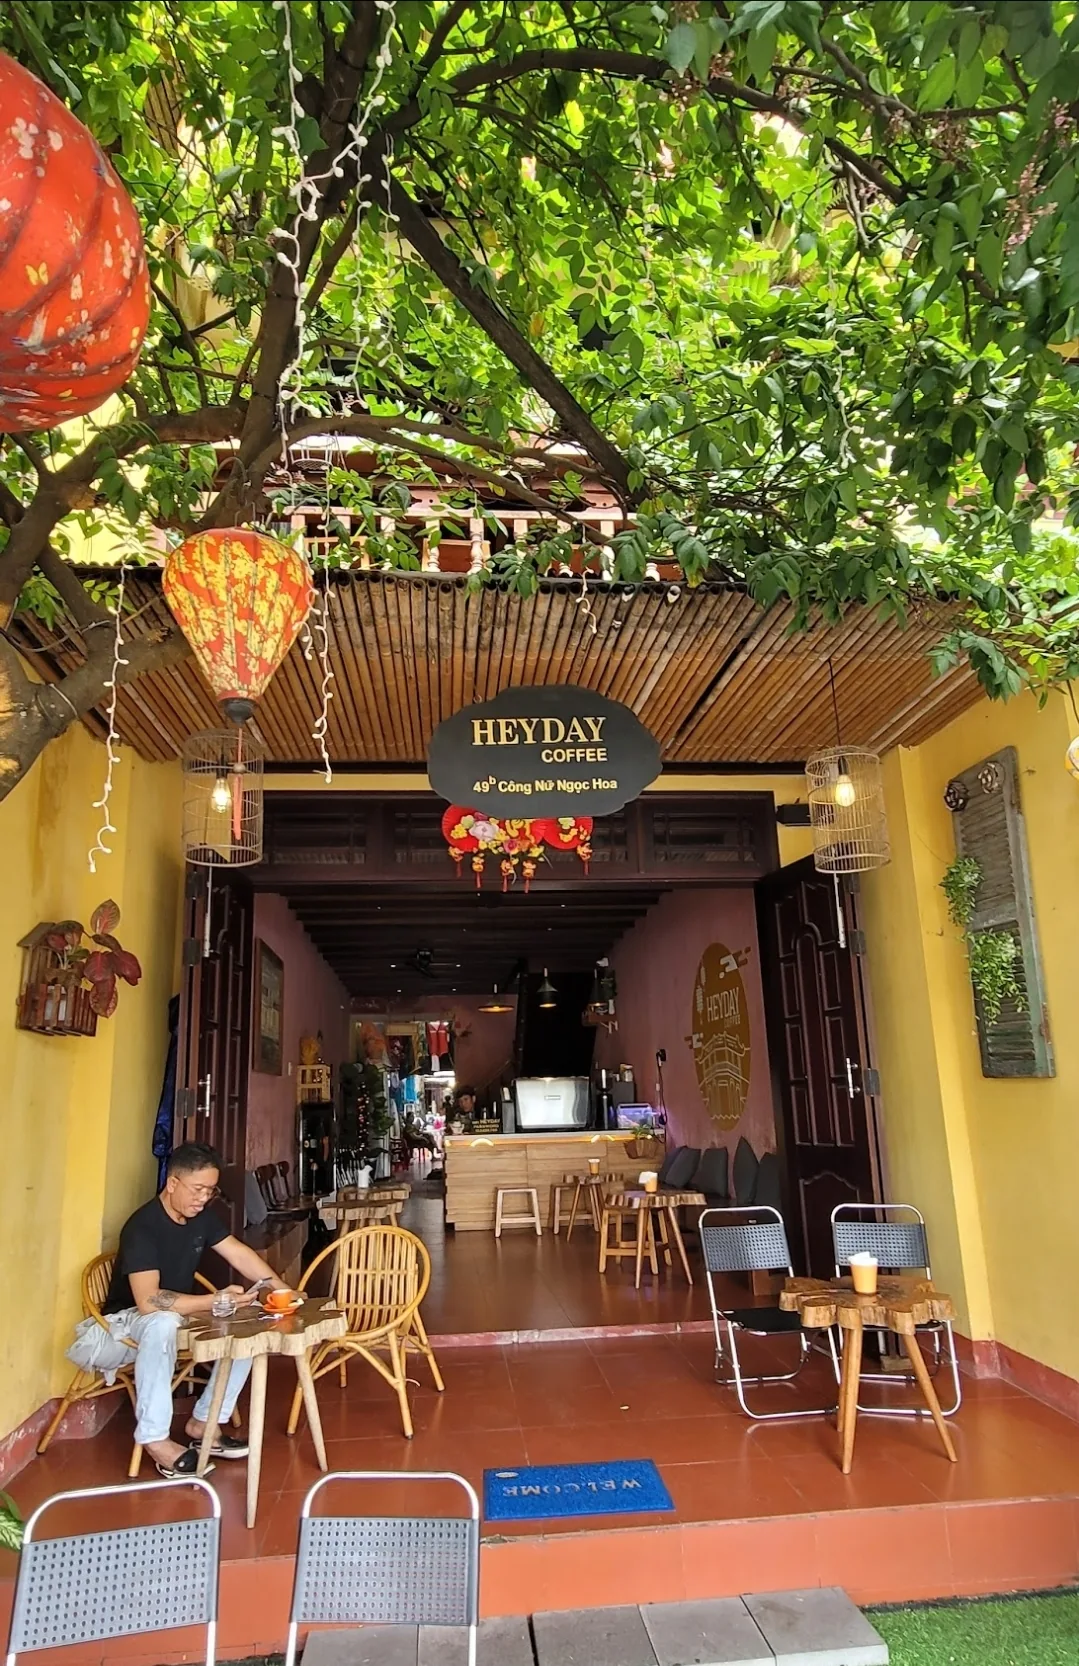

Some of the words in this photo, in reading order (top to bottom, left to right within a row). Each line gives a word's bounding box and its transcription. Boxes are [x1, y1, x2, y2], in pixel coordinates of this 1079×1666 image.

[471, 716, 606, 745] HEYDAY
[541, 748, 608, 763] COFFEE
[498, 780, 532, 795] Công
[556, 779, 590, 794] Ngọc
[592, 778, 618, 790] Hoa
[706, 986, 740, 1023] HEYDAY
[502, 1479, 642, 1497] WELCOME
